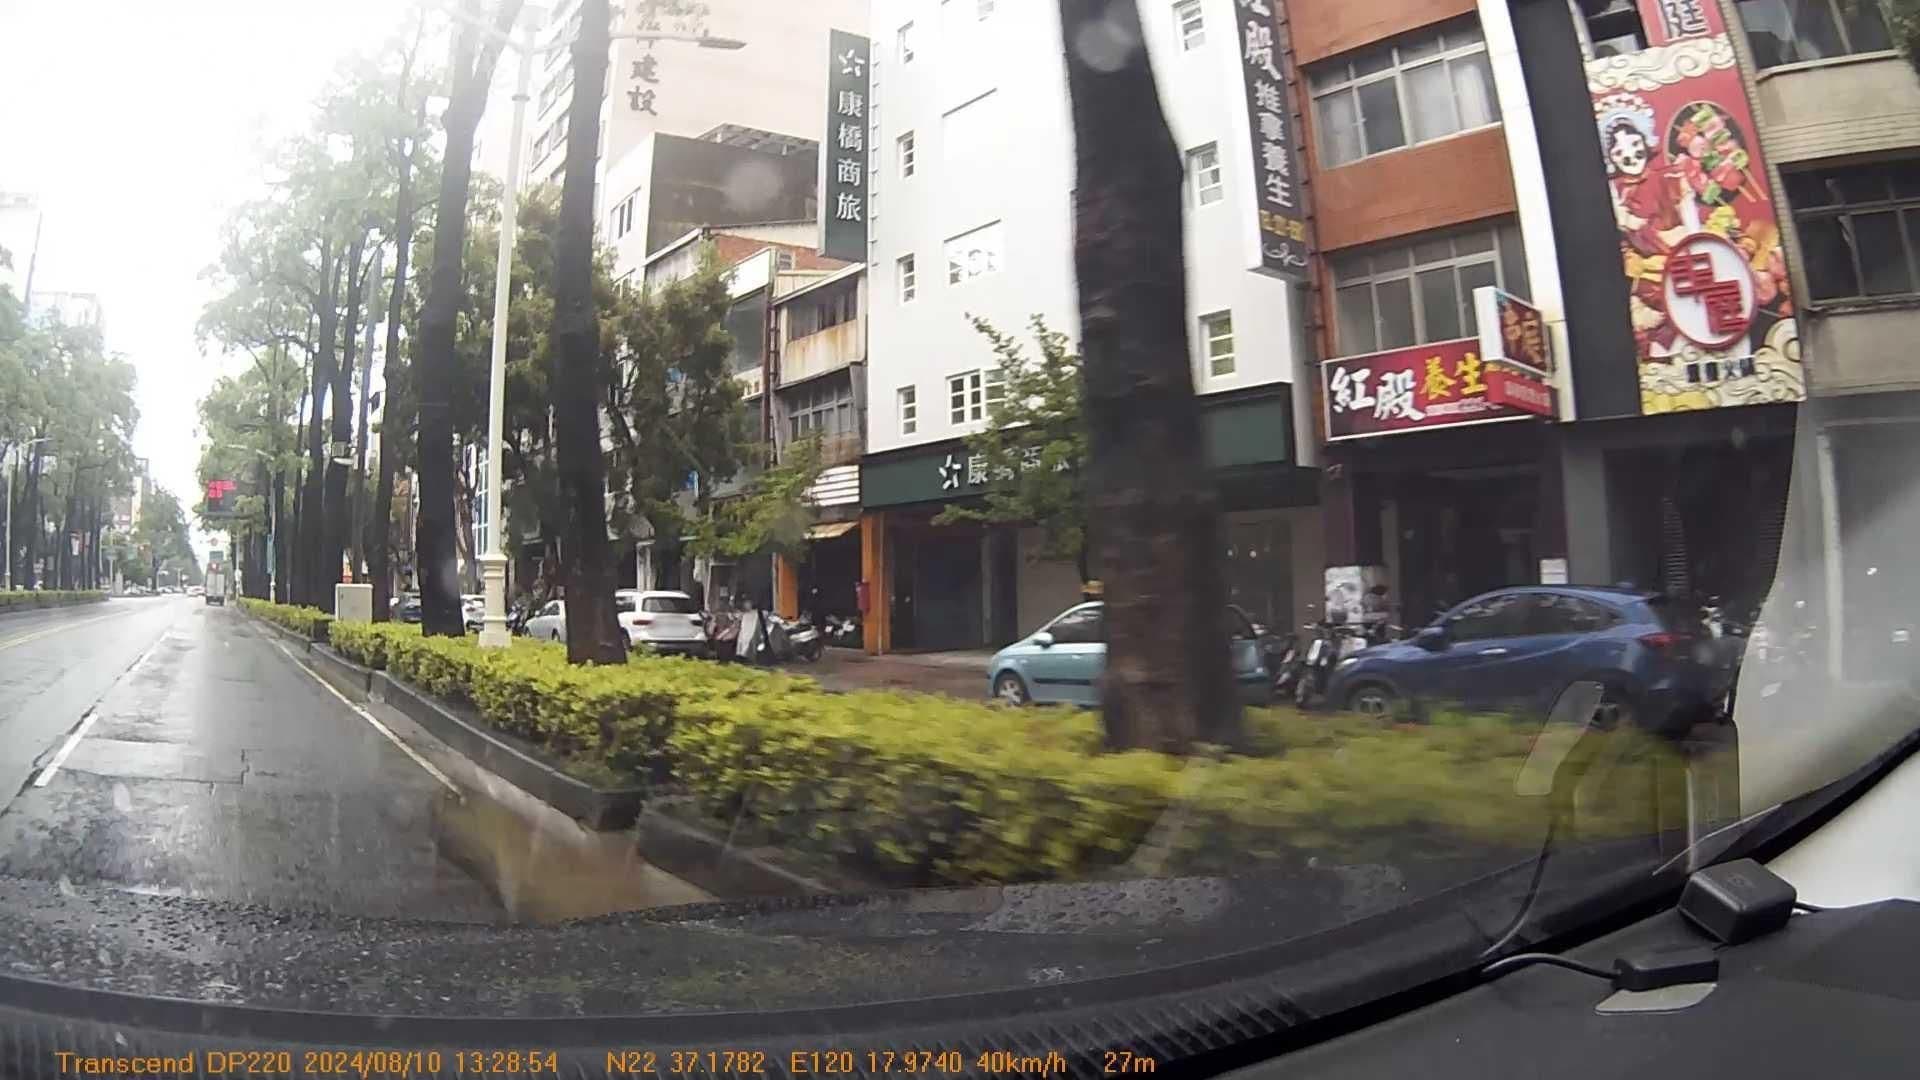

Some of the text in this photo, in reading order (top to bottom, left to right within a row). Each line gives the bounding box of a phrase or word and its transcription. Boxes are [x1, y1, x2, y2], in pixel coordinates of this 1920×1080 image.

[835, 89, 864, 222] 康橋商旅
[1330, 351, 1489, 422] 紅殿養生
